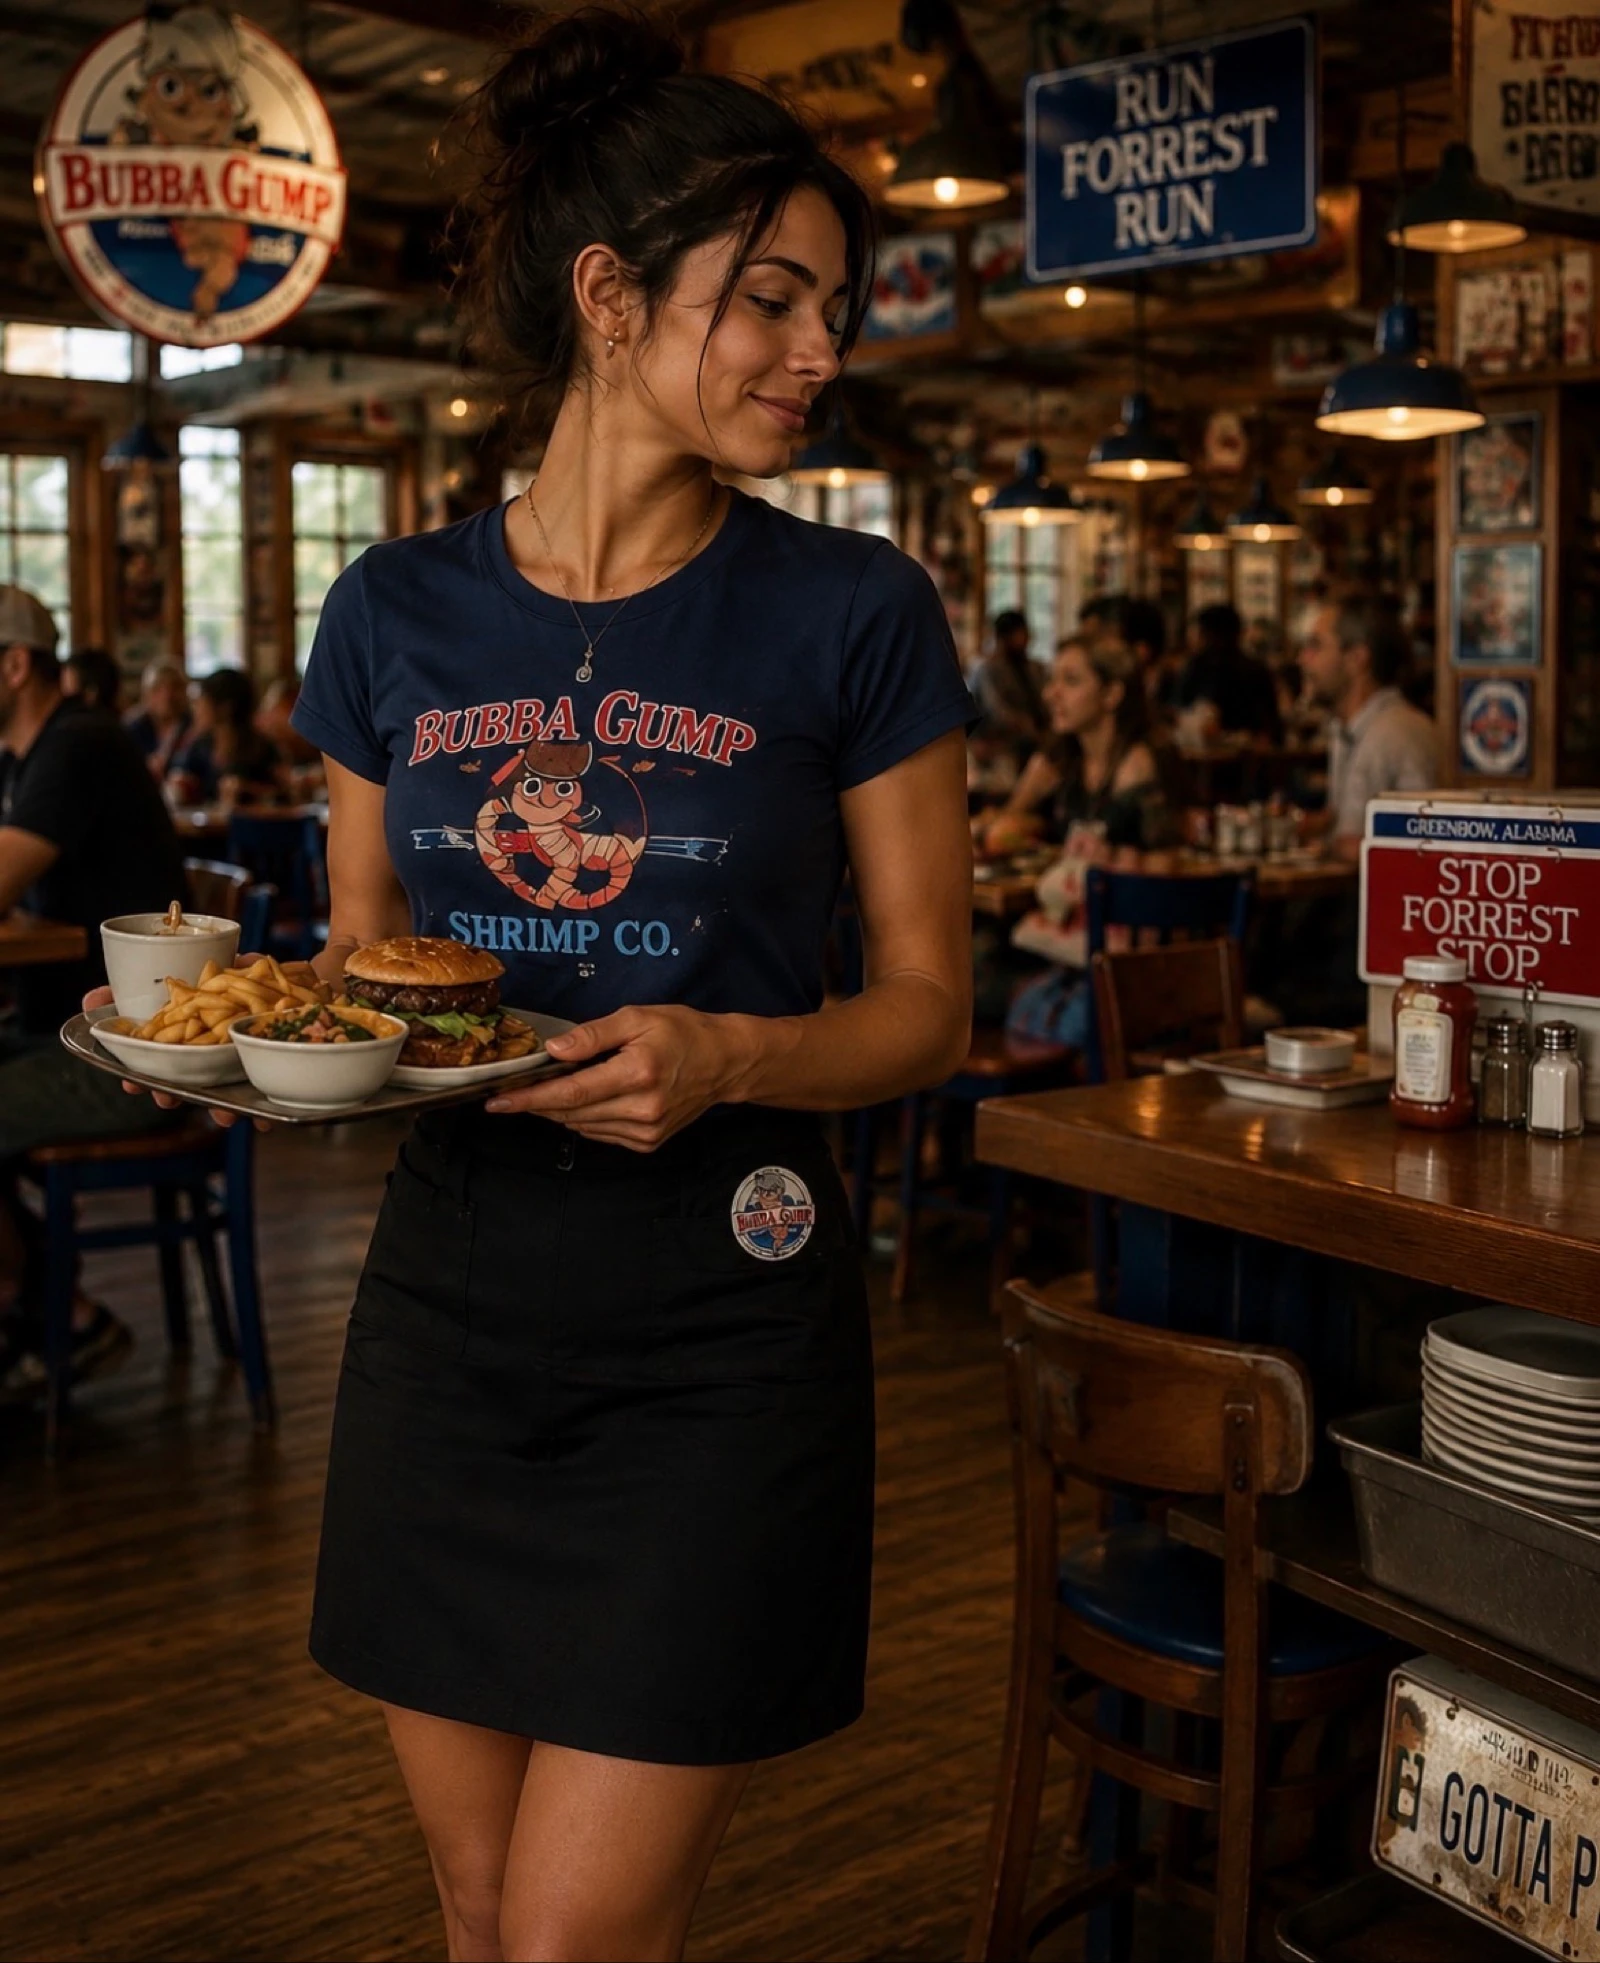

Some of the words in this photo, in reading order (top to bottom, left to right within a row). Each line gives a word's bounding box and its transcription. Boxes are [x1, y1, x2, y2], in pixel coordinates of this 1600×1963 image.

[1115, 56, 1215, 130] RUN
[1060, 106, 1278, 199] FORREST
[60, 153, 209, 211] BUBBA
[220, 158, 333, 225] GUMP
[1114, 179, 1215, 249] RUN
[408, 696, 580, 766] BUBBA
[594, 689, 757, 766] GUMP
[1501, 824, 1577, 843] ALABAMA
[1438, 857, 1542, 900] STOP
[449, 912, 599, 953] SHRIMP
[613, 919, 680, 957] CO.
[1402, 895, 1579, 945] FORREST
[1436, 938, 1540, 982] STOP
[1439, 1771, 1553, 1906] GOTTA
[1568, 1833, 1600, 1932] P
